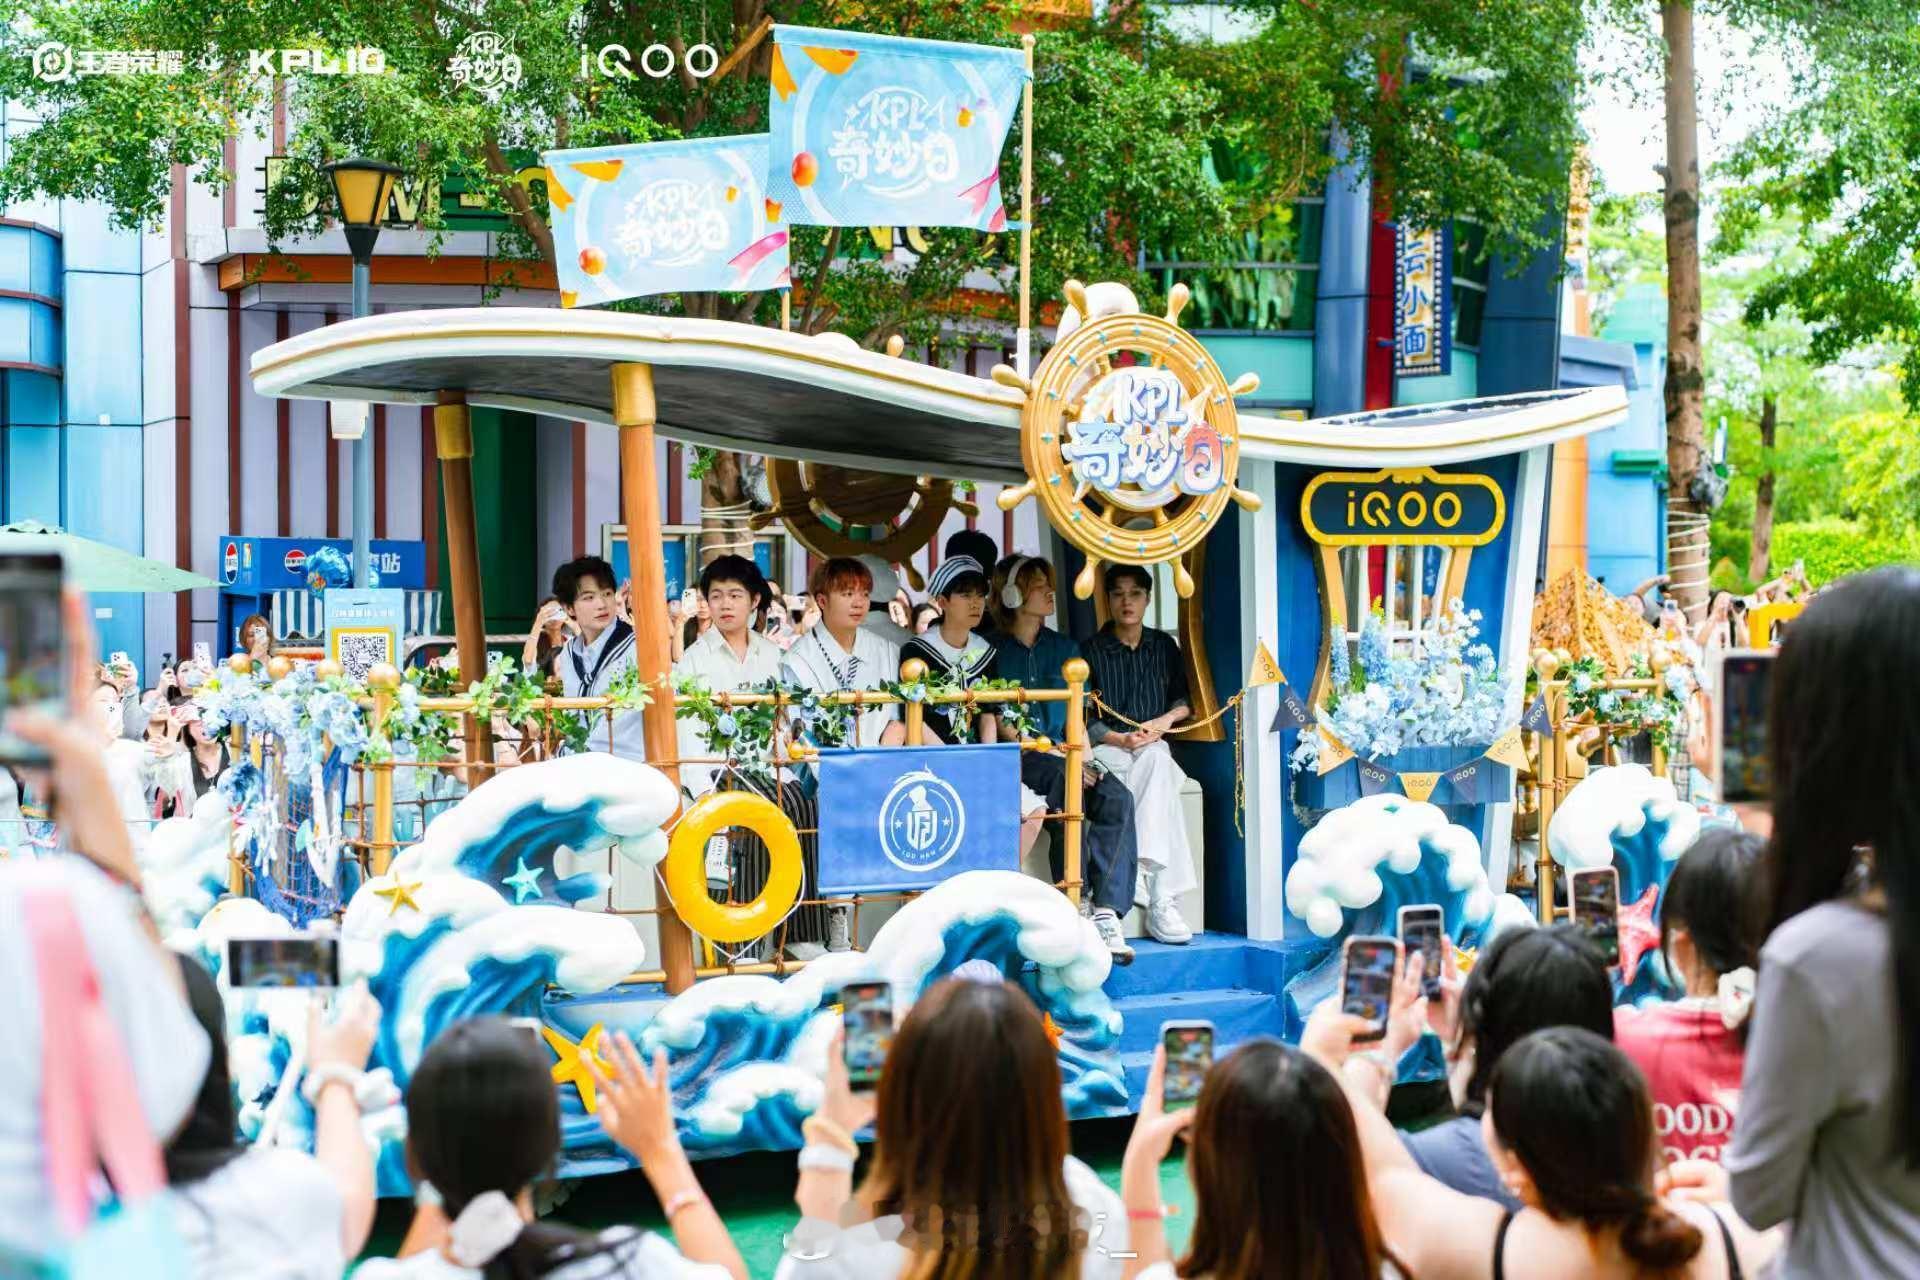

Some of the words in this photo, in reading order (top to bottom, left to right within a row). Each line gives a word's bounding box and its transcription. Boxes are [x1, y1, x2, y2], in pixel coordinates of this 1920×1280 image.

[868, 93, 926, 130] KPL
[1116, 375, 1188, 425] KPL
[1347, 490, 1463, 527] iQOO
[1284, 695, 1305, 722] iQOO
[1361, 767, 1386, 782] iQOO
[1453, 766, 1476, 784] iQOO
